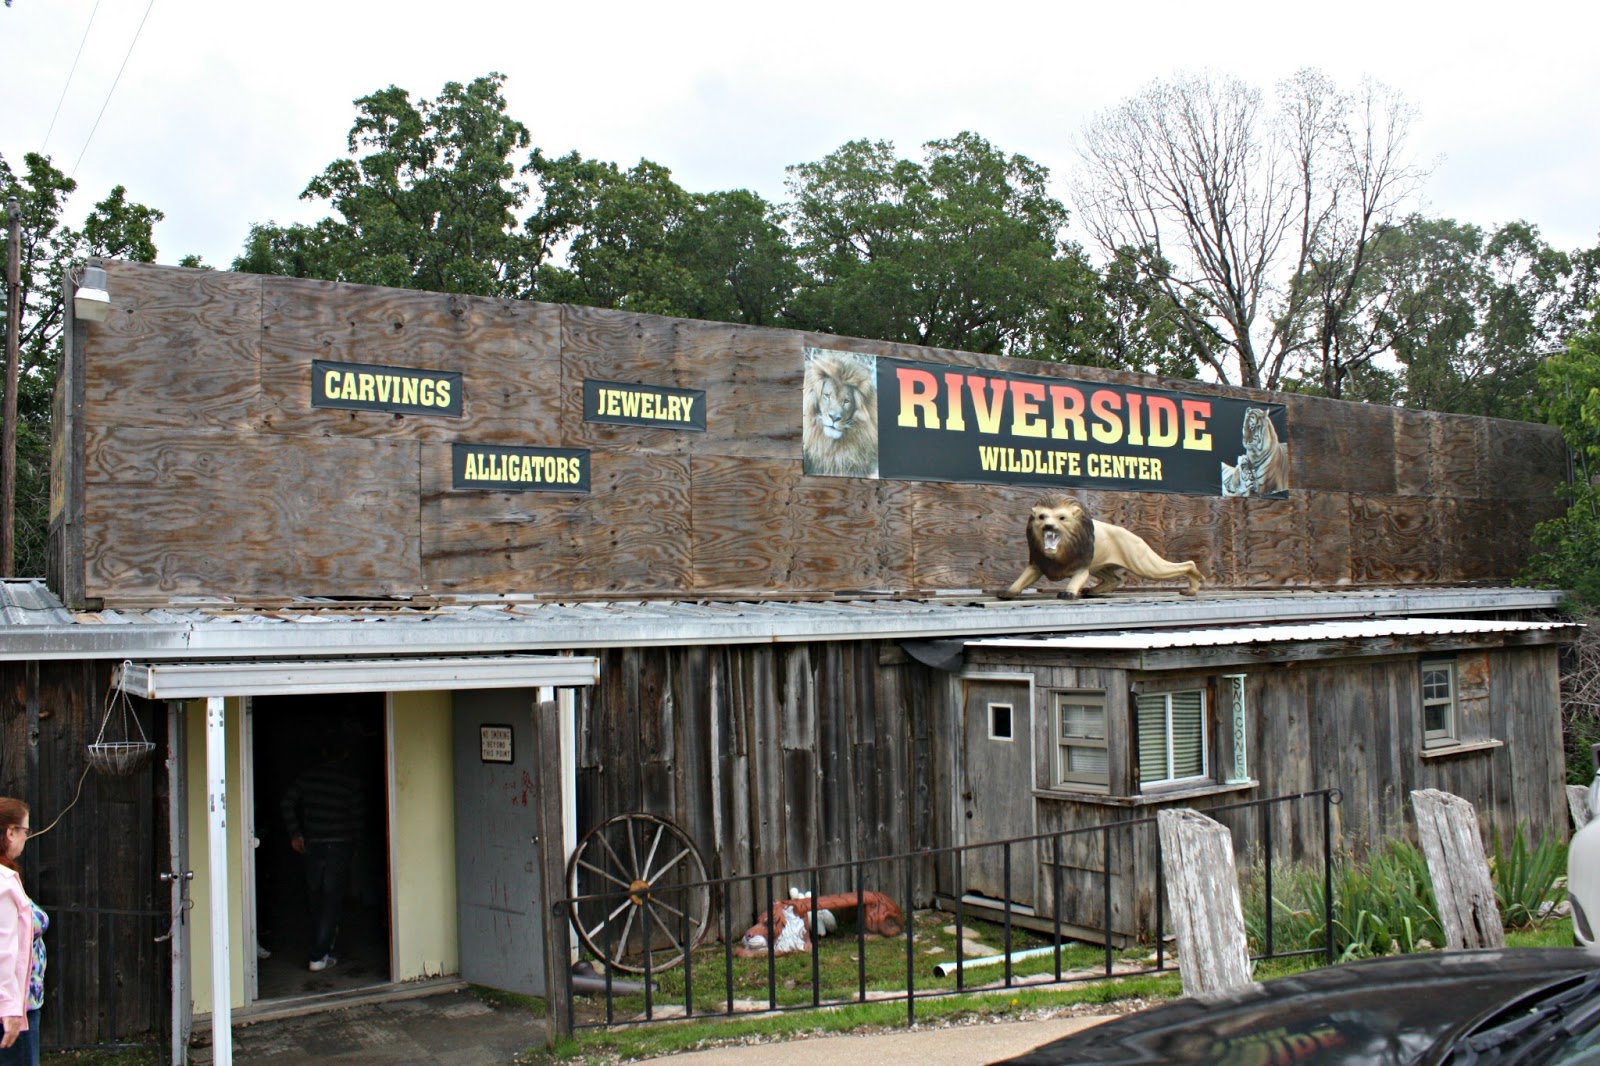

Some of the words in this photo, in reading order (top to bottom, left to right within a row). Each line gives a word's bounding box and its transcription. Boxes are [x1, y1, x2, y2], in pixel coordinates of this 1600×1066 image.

[324, 370, 451, 407] CARVINGS
[597, 388, 694, 422] JEWELRY
[896, 367, 1213, 452] RIVERSIDE
[464, 453, 581, 484] ALLIGATORS
[979, 445, 1081, 476] WILDLIFE
[1087, 453, 1163, 481] CENTER
[1233, 678, 1242, 713] SNO
[496, 750, 511, 758] POINT
[1234, 717, 1244, 778] CONES
